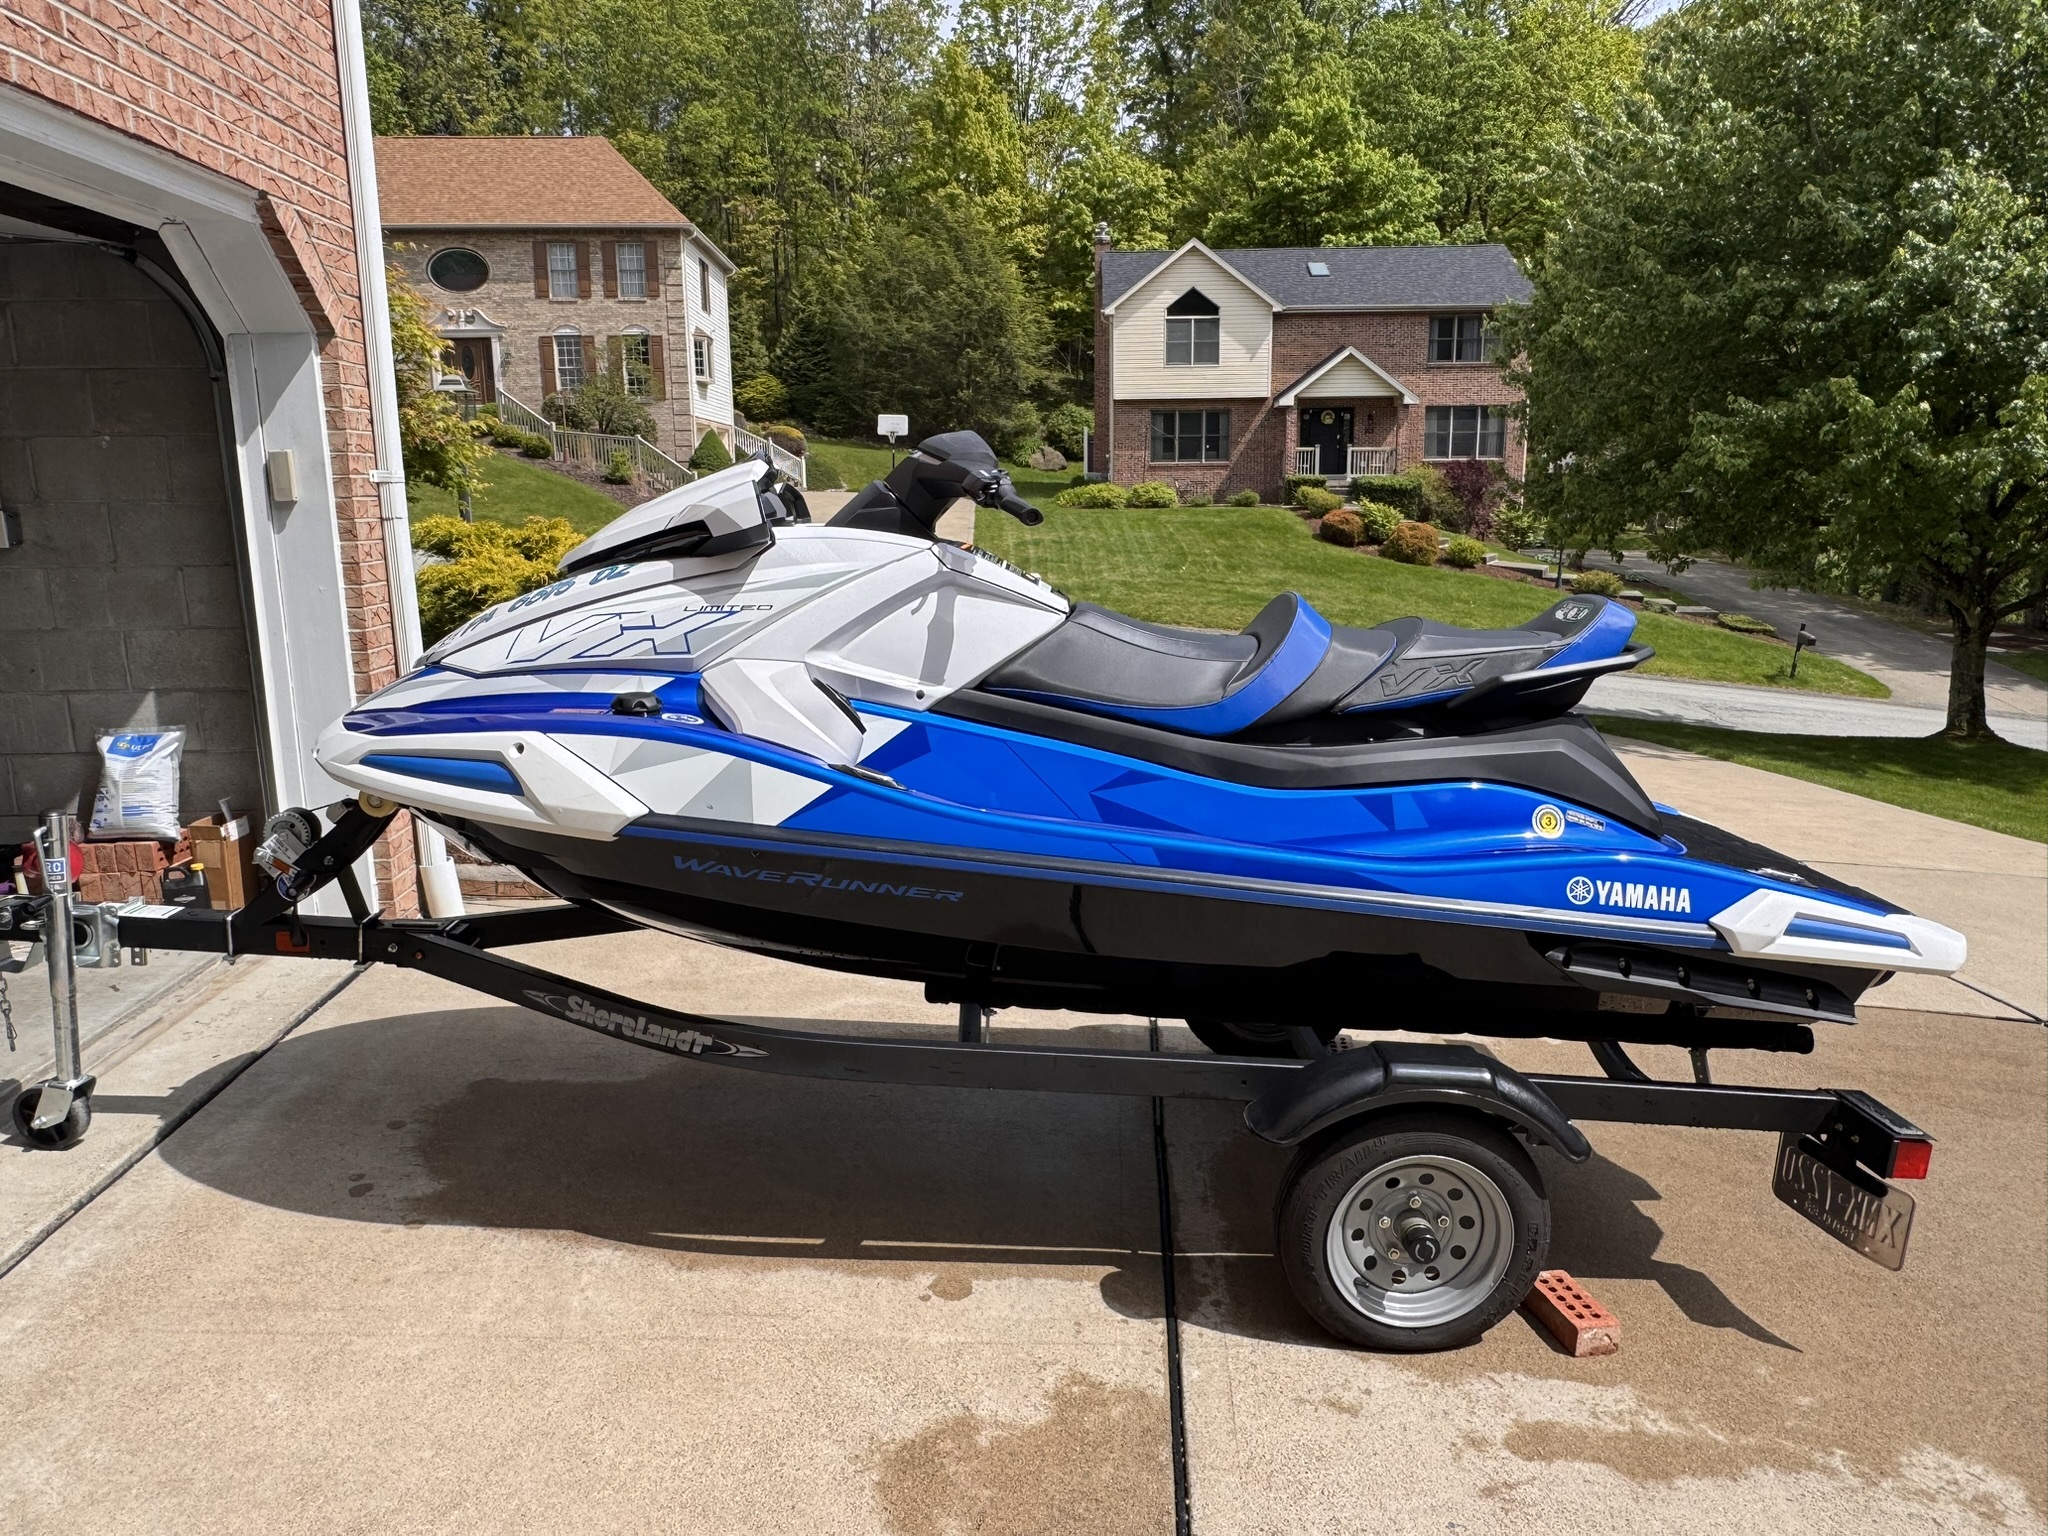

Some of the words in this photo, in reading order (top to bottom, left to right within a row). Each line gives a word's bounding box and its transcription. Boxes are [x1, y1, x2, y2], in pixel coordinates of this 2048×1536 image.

[683, 604, 773, 612] LIMITED
[506, 609, 743, 664] VX
[1380, 657, 1487, 697] VX
[1545, 816, 1552, 828] 3
[1596, 879, 1692, 914] YAMAHA
